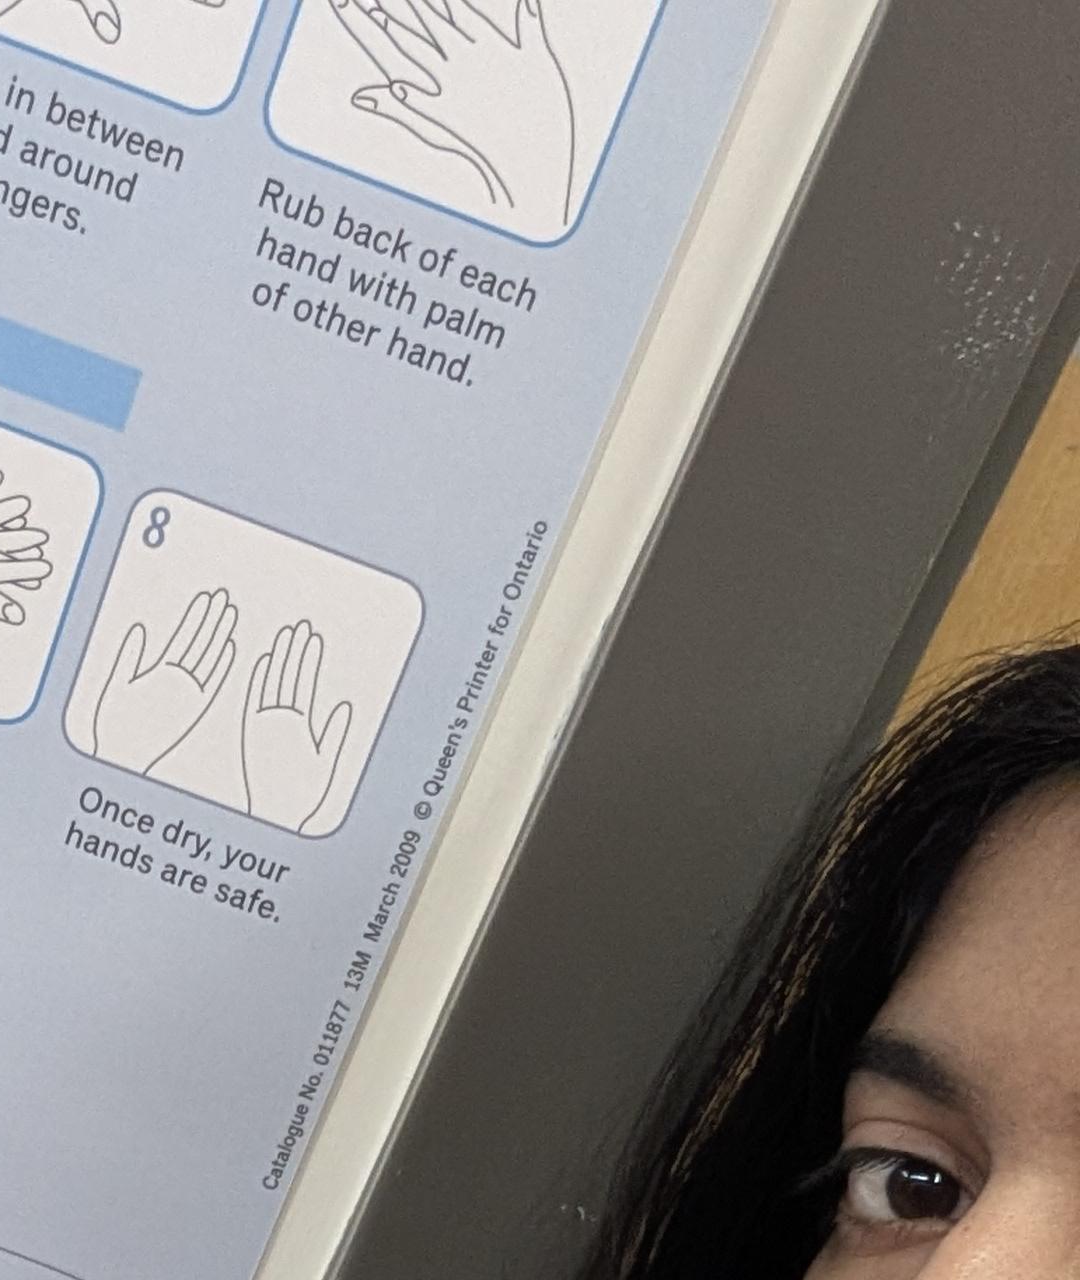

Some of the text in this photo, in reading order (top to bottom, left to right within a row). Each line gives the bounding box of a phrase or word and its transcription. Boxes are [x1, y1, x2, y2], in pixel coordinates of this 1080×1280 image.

[4, 74, 36, 115] in
[45, 90, 185, 173] between
[19, 140, 139, 203] around
[255, 225, 506, 350] hand with palm
[258, 177, 537, 313] Rub back of each
[251, 281, 473, 387] of other hand.
[141, 505, 172, 549] 8
[64, 819, 280, 923] hands are safe.
[79, 786, 291, 884] Once dry, your
[262, 1103, 310, 1191] Catalogue
[297, 1071, 324, 1102] No.
[312, 999, 351, 1066] 011877
[343, 950, 372, 993] 13M
[362, 882, 401, 943] March
[389, 829, 422, 879] 2009
[422, 717, 469, 797] Queen's
[455, 639, 499, 714] Printer
[487, 604, 513, 636] for
[502, 520, 548, 601] Ontario
